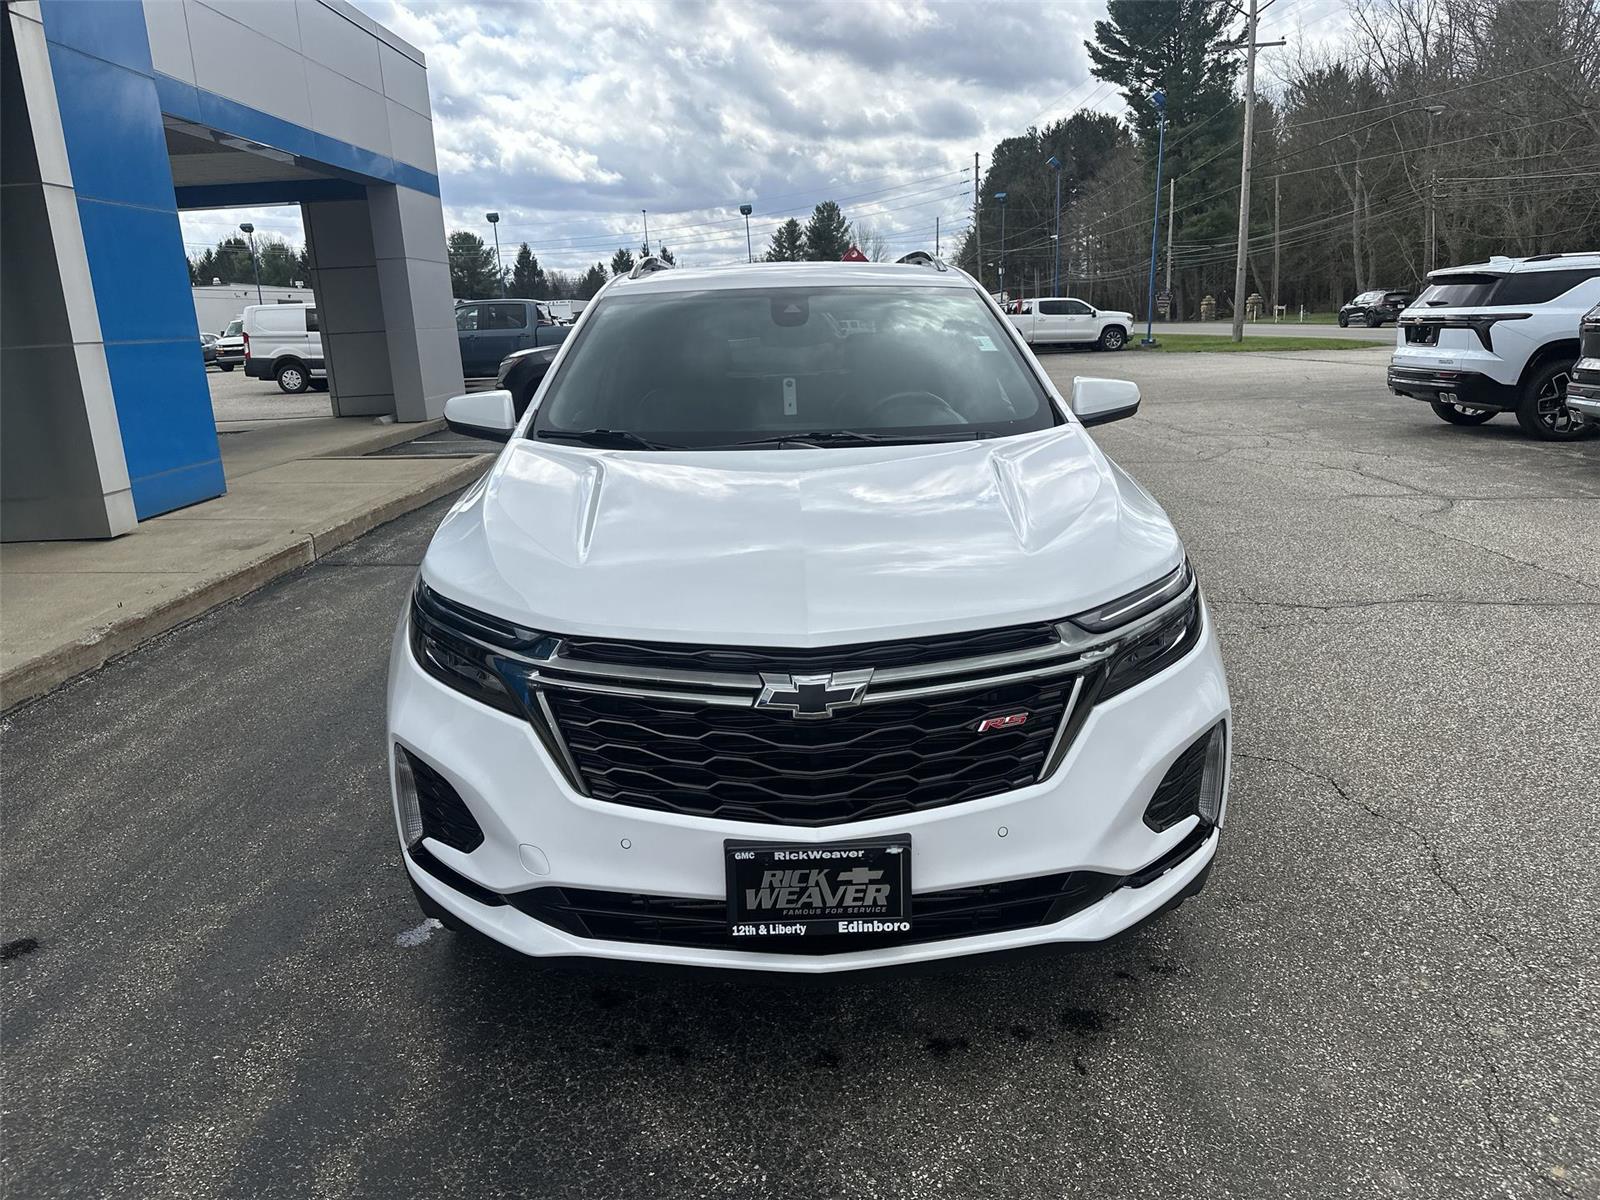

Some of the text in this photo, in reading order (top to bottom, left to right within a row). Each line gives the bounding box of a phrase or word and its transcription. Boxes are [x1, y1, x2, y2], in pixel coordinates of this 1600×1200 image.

[978, 712, 1029, 732] RS
[734, 852, 755, 860] GMC
[761, 868, 832, 888] RICK
[745, 884, 891, 910] WEAVER
[847, 906, 887, 914] SERVICE
[732, 923, 807, 936] 12th & Liberty
[838, 920, 910, 933] Edinboro
